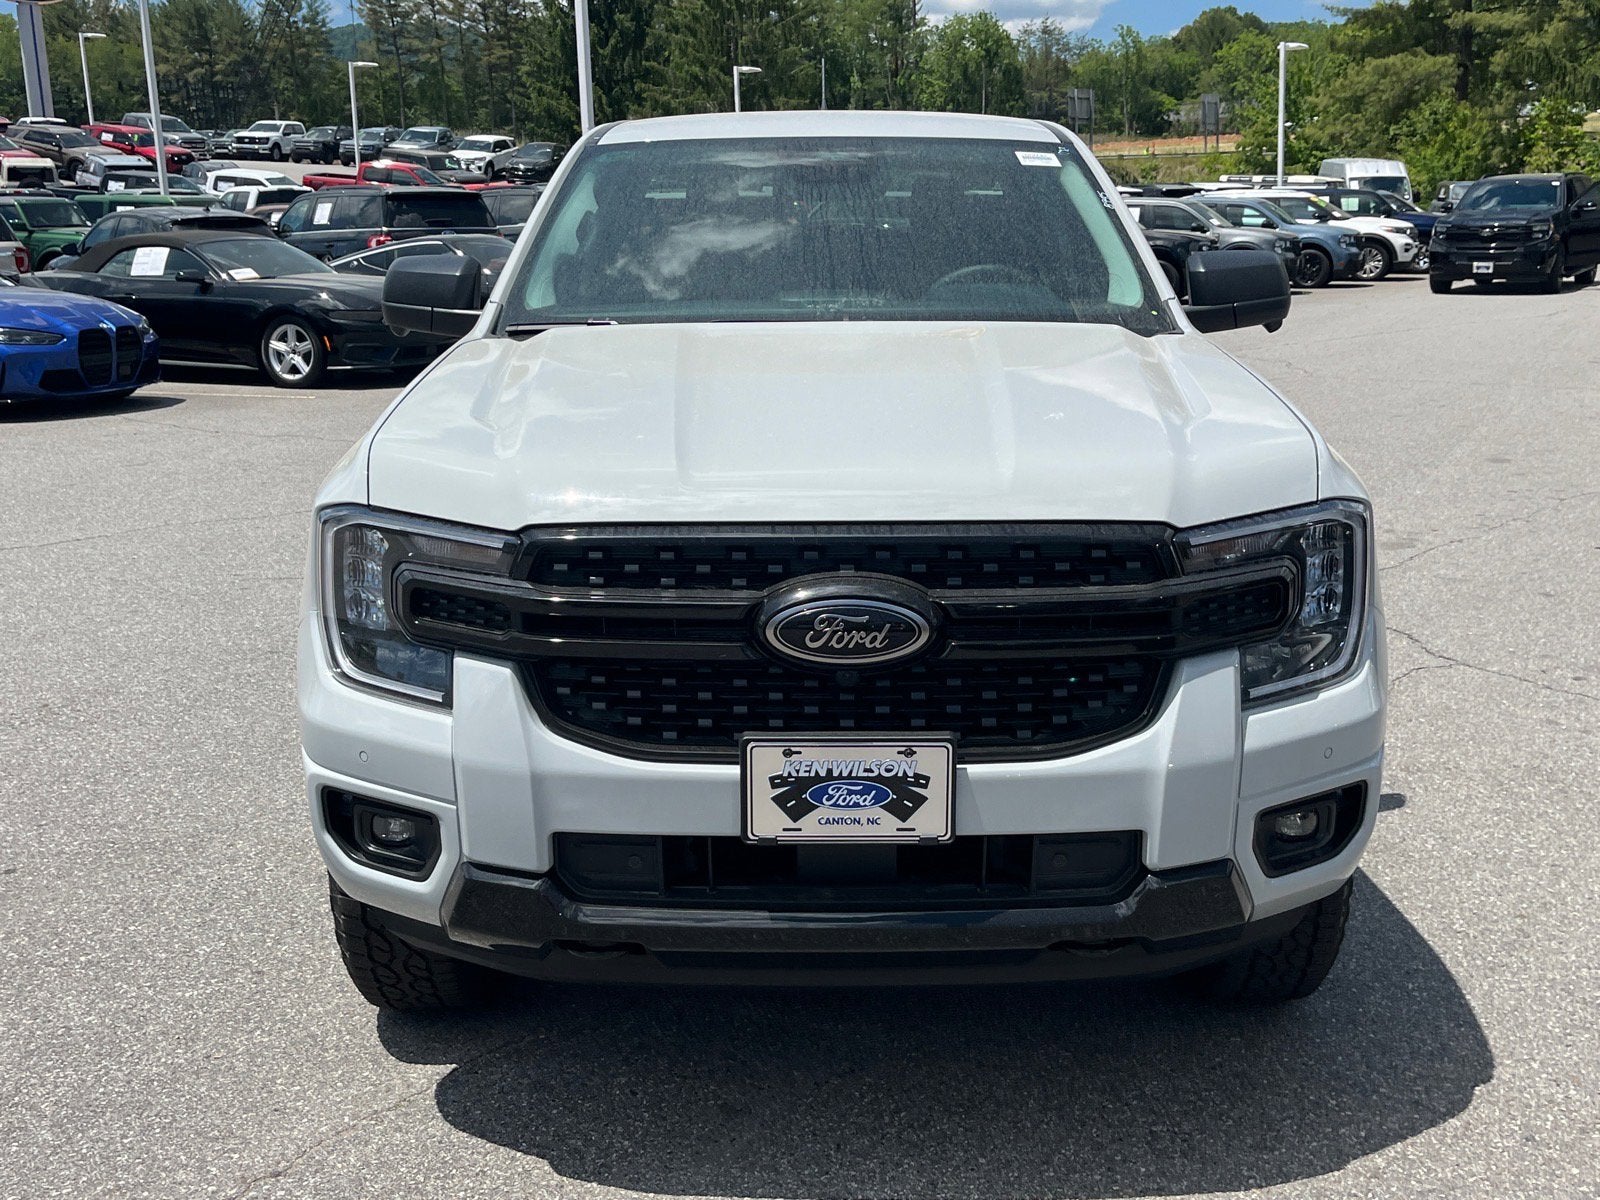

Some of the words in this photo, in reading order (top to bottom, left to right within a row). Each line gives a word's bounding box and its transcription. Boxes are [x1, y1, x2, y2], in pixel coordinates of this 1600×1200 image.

[805, 613, 892, 649] Ford
[782, 759, 830, 777] KEN
[832, 759, 917, 777] WILSON
[822, 784, 876, 806] Ford
[817, 817, 864, 827] CANTON,
[866, 817, 881, 826] NC
